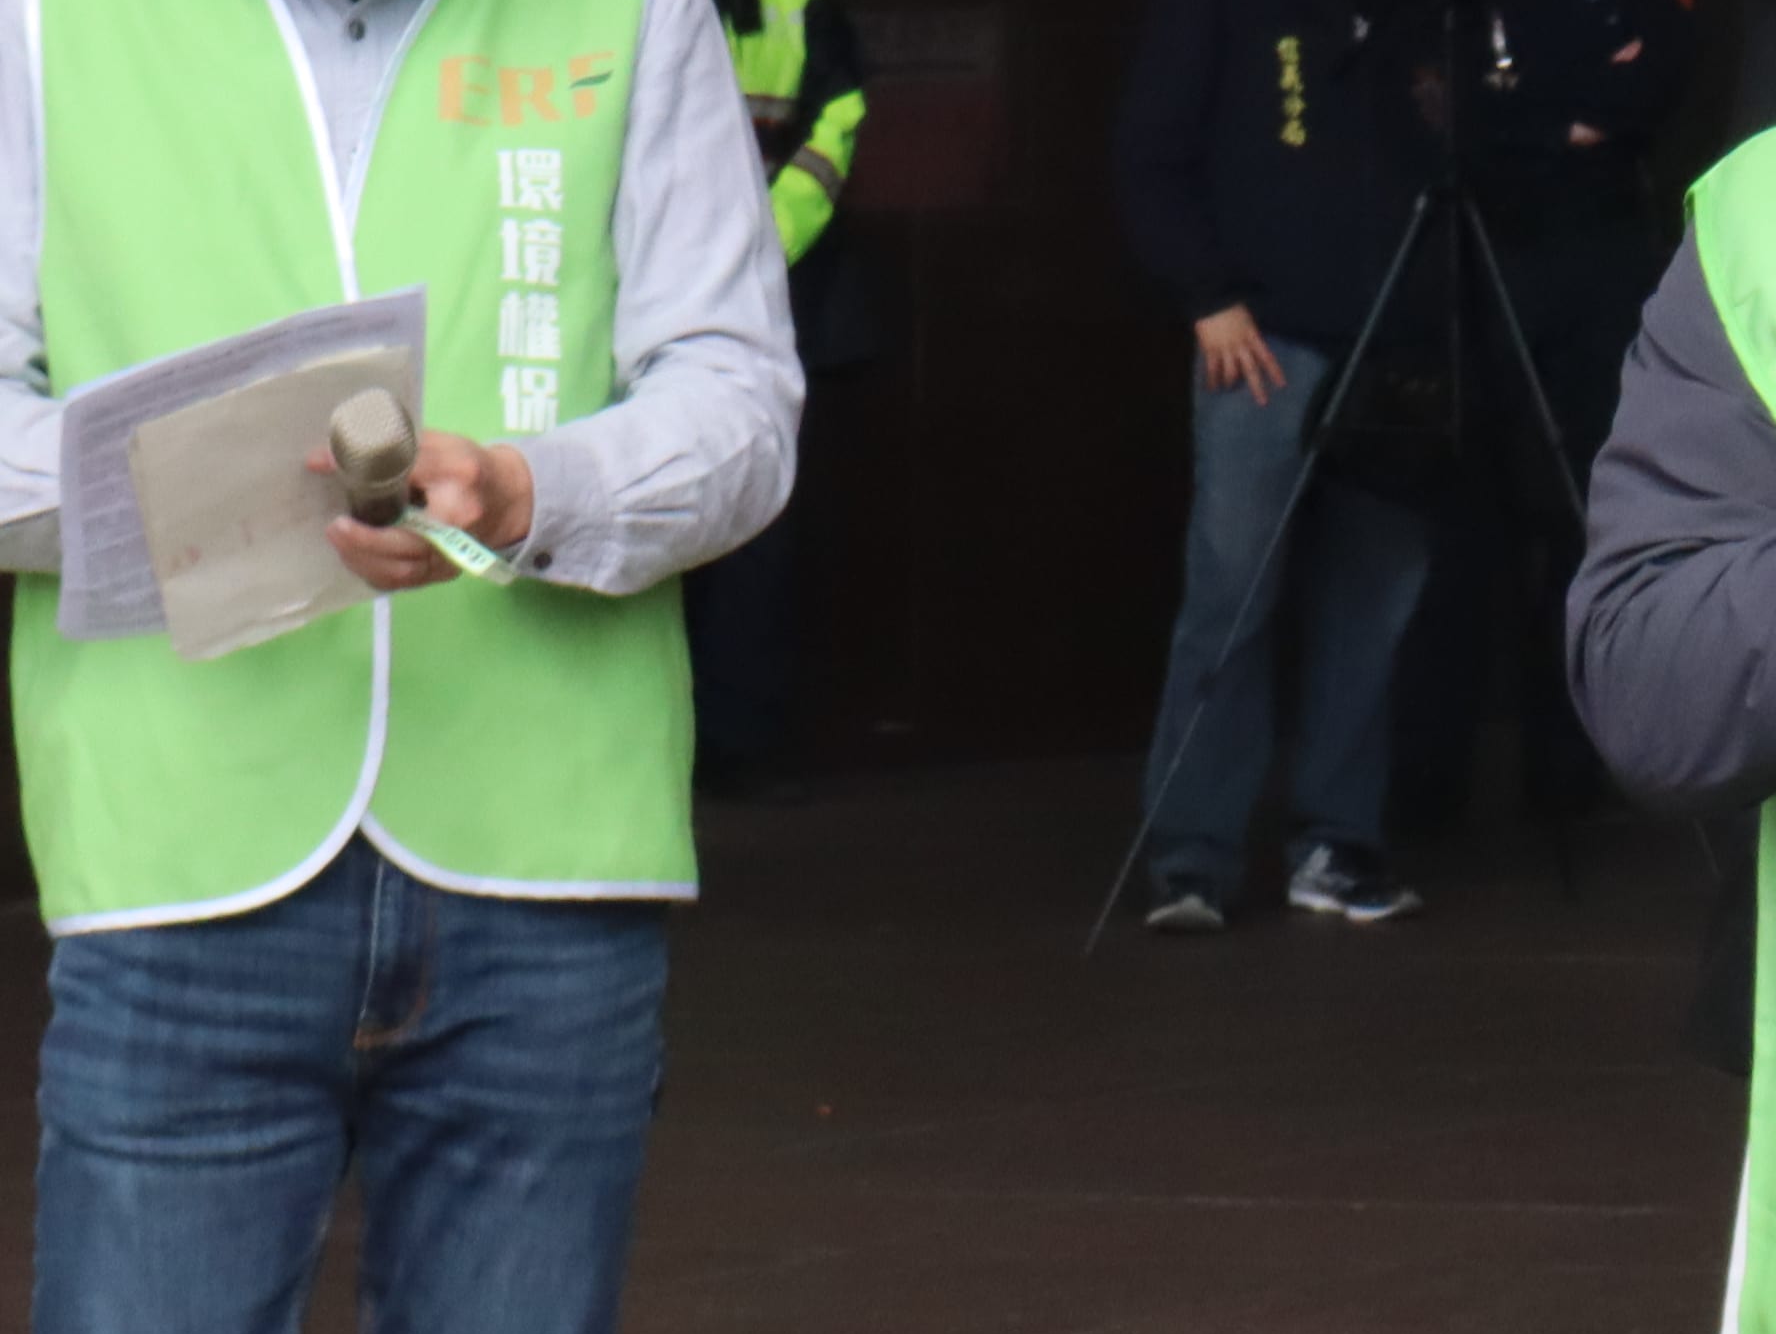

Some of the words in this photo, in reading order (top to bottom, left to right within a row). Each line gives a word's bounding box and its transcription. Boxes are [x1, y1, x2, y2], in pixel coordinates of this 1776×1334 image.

[437, 50, 616, 127] ERF
[497, 147, 563, 433] 環境權保
